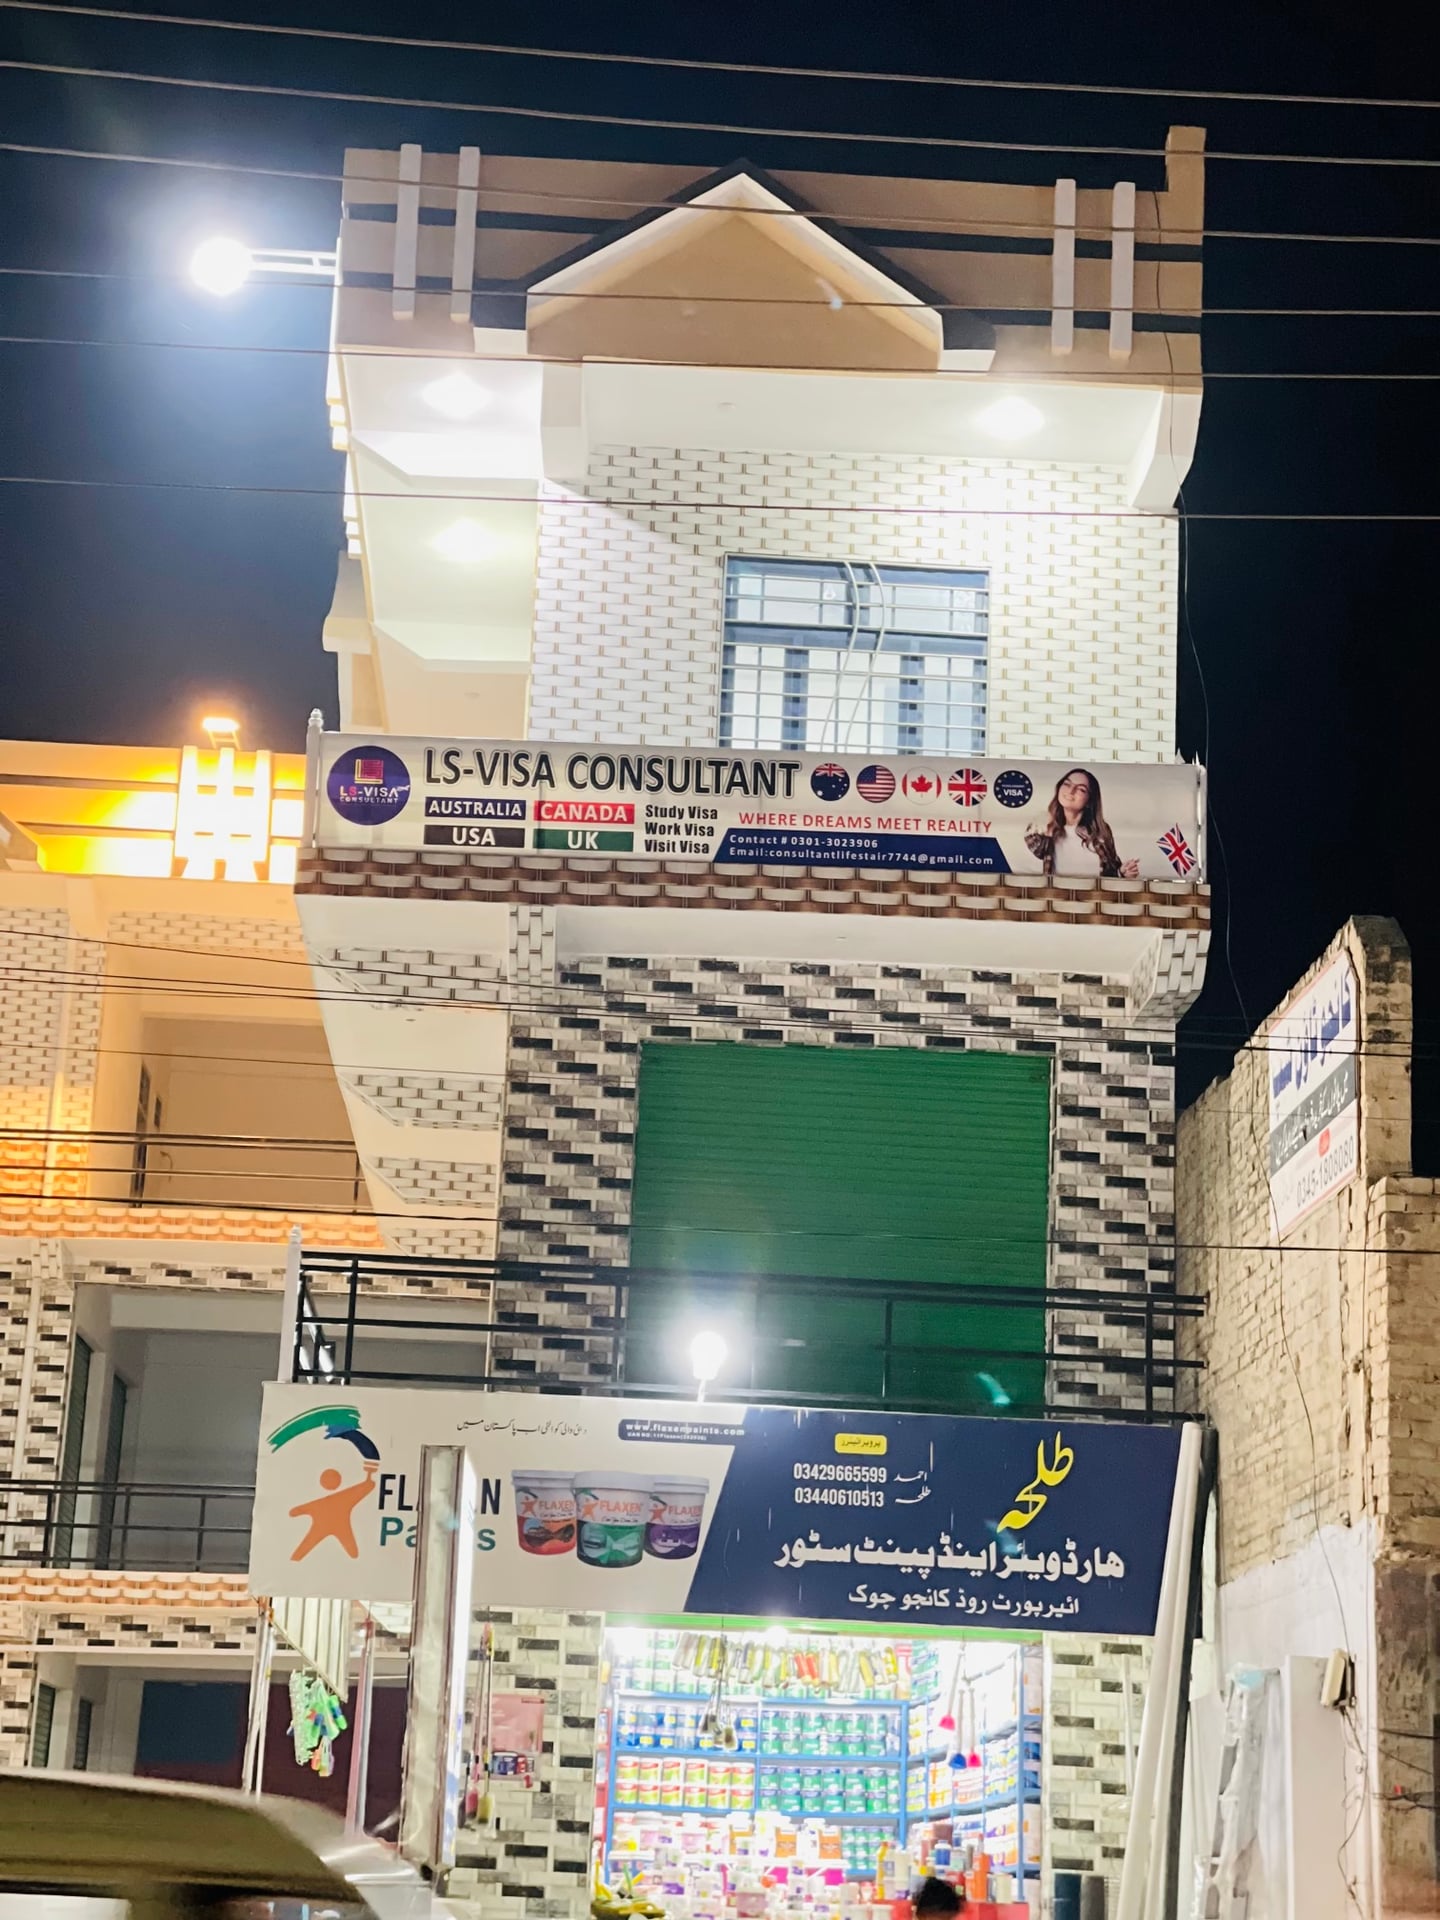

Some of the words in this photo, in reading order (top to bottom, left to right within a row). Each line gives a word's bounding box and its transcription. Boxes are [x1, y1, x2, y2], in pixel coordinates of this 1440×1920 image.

[425, 750, 556, 789] LS-VISA
[567, 755, 800, 797] CONSULTANT
[340, 785, 399, 798] LS-VISA
[1003, 789, 1024, 797] VISA
[428, 800, 523, 817] AUSTRALIA
[540, 803, 628, 822] CANADA
[645, 805, 685, 820] Study
[688, 806, 718, 820] Visa
[645, 822, 682, 837] Work
[685, 823, 715, 837] Visa
[739, 812, 797, 826] WHERE
[803, 814, 872, 829] DREAMS
[877, 817, 922, 831] MEET
[927, 819, 992, 833] REALITY
[452, 827, 497, 846] USA
[567, 831, 600, 850] UK
[730, 834, 778, 845] Contact
[781, 836, 788, 845] #
[791, 836, 879, 848] 0301-3023906
[645, 839, 676, 854] Visit
[679, 841, 710, 854] Visa
[793, 1462, 887, 1483] 03429665599
[997, 1431, 1075, 1533] طلحہ
[378, 1474, 501, 1515] FLN
[795, 1487, 885, 1507] 03440610513
[848, 1584, 896, 1609] چوک
[899, 1588, 951, 1610] کانجو
